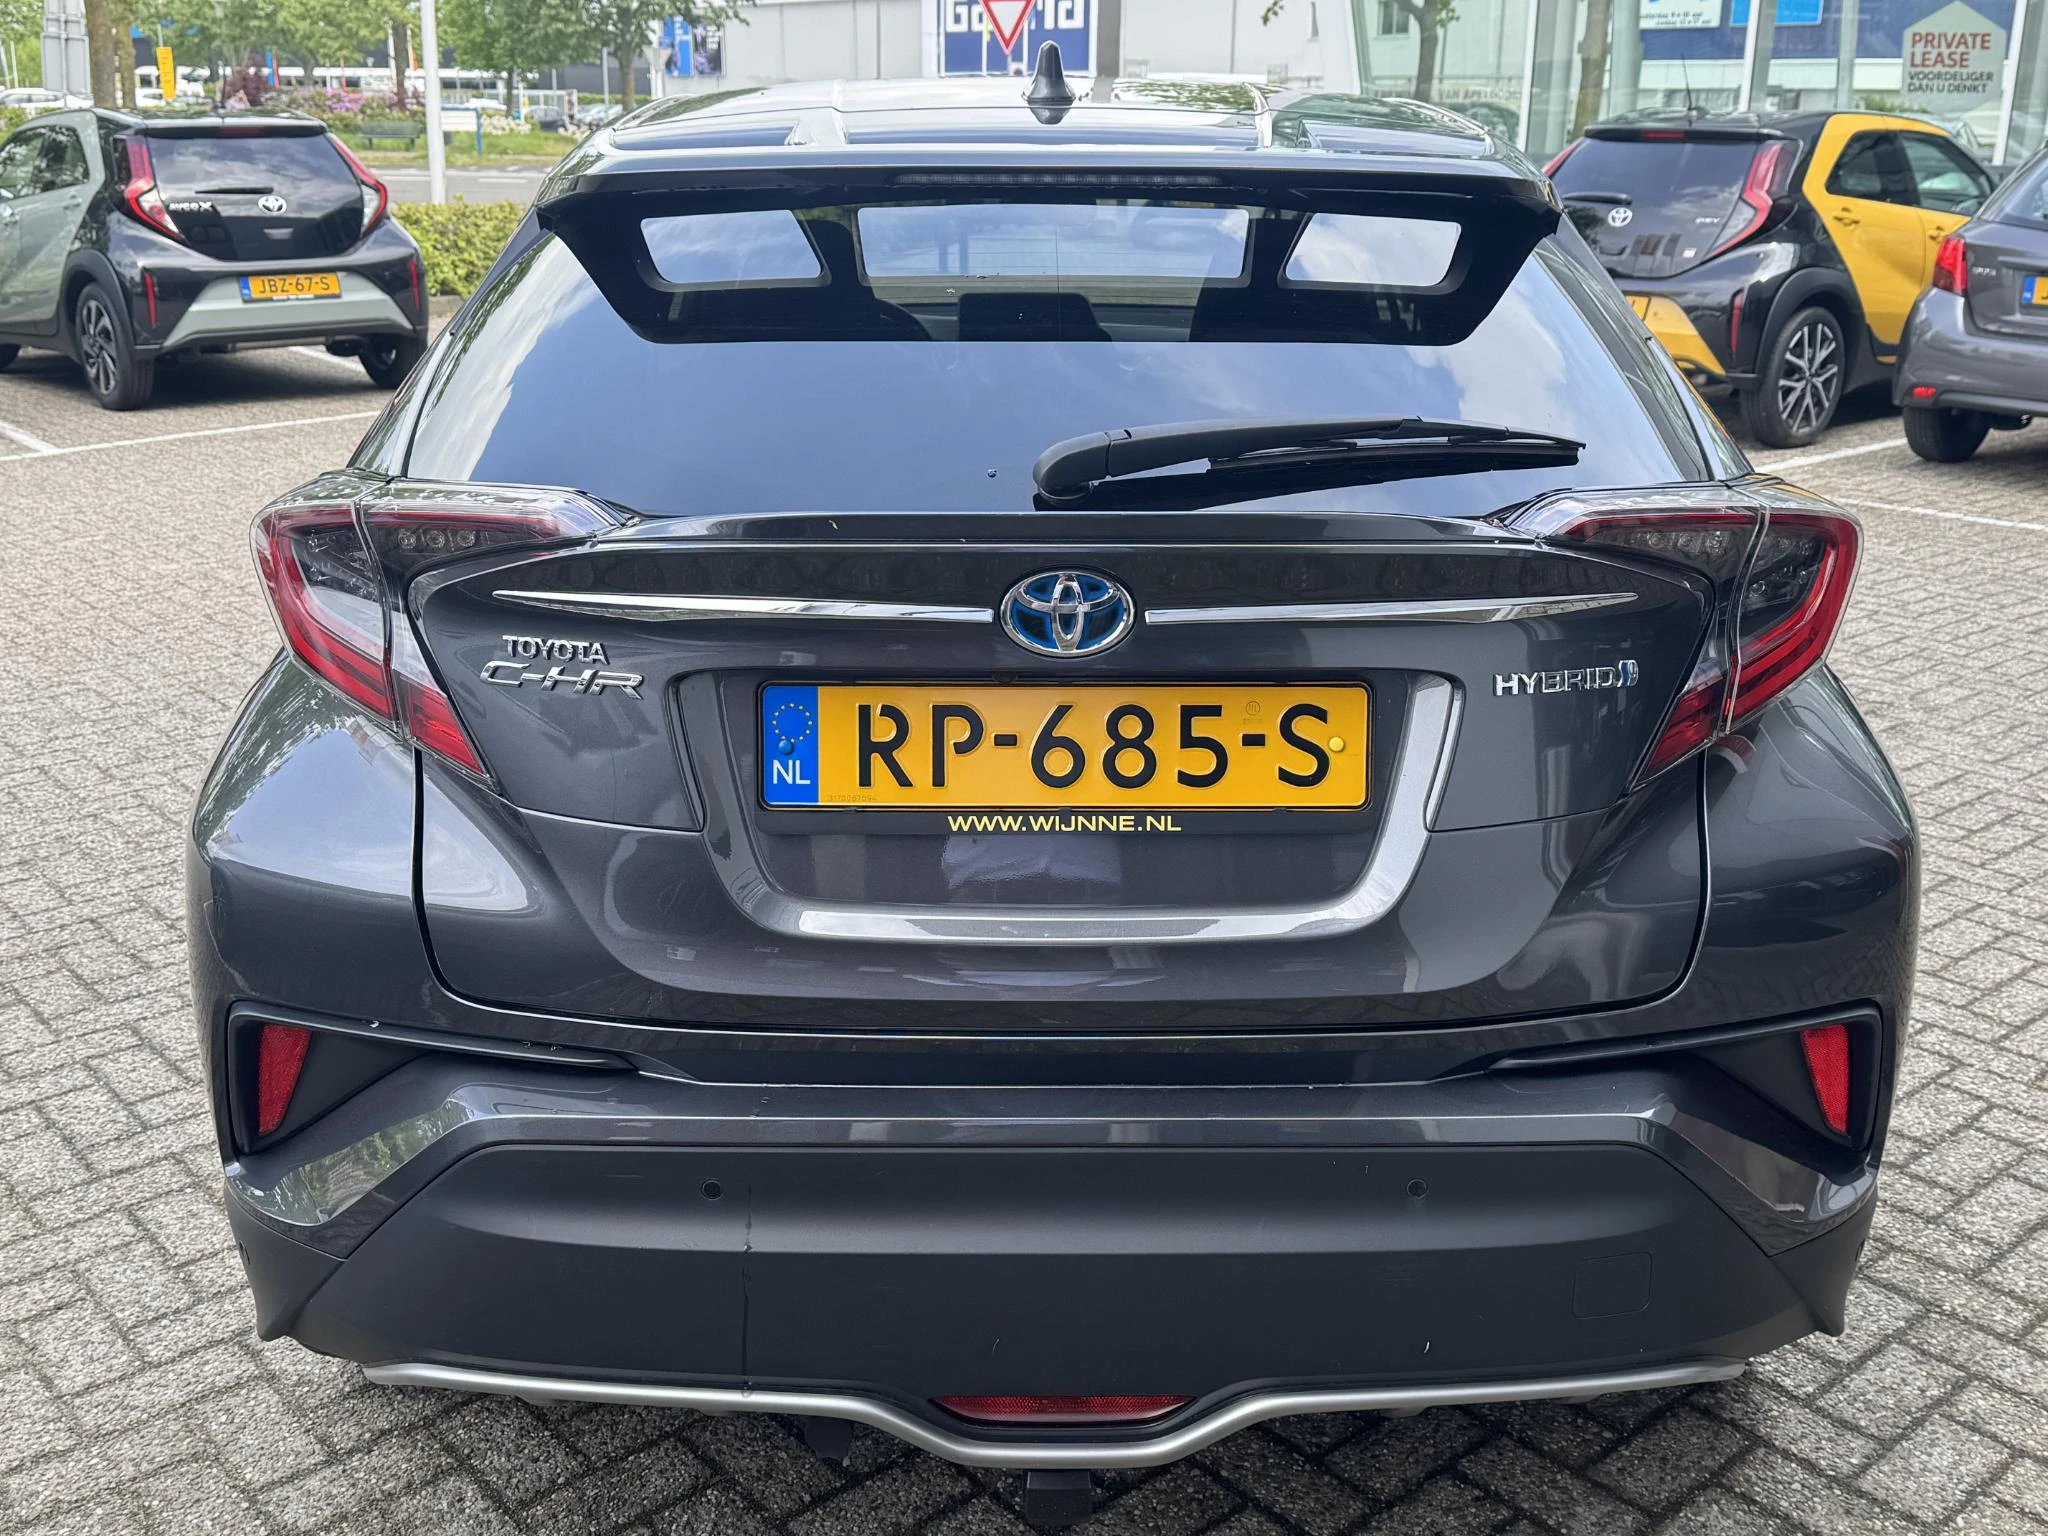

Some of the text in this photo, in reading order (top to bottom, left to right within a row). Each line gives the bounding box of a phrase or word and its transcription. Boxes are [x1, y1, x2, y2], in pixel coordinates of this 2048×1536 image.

[1911, 32, 1991, 50] PRIVATE
[1910, 51, 1970, 68] LEASE
[1908, 70, 1994, 82] VOORDELIGER
[1907, 82, 1987, 93] DAN U DENKT
[259, 276, 330, 294] JBZ-67-S
[502, 634, 609, 665] TOYOTA
[479, 660, 644, 701] C-HR
[1493, 666, 1617, 697] HYBRID
[858, 703, 1330, 789] RP-685-S
[772, 759, 811, 786] NL
[947, 815, 1182, 832] WWW.WIJNNE.NL
